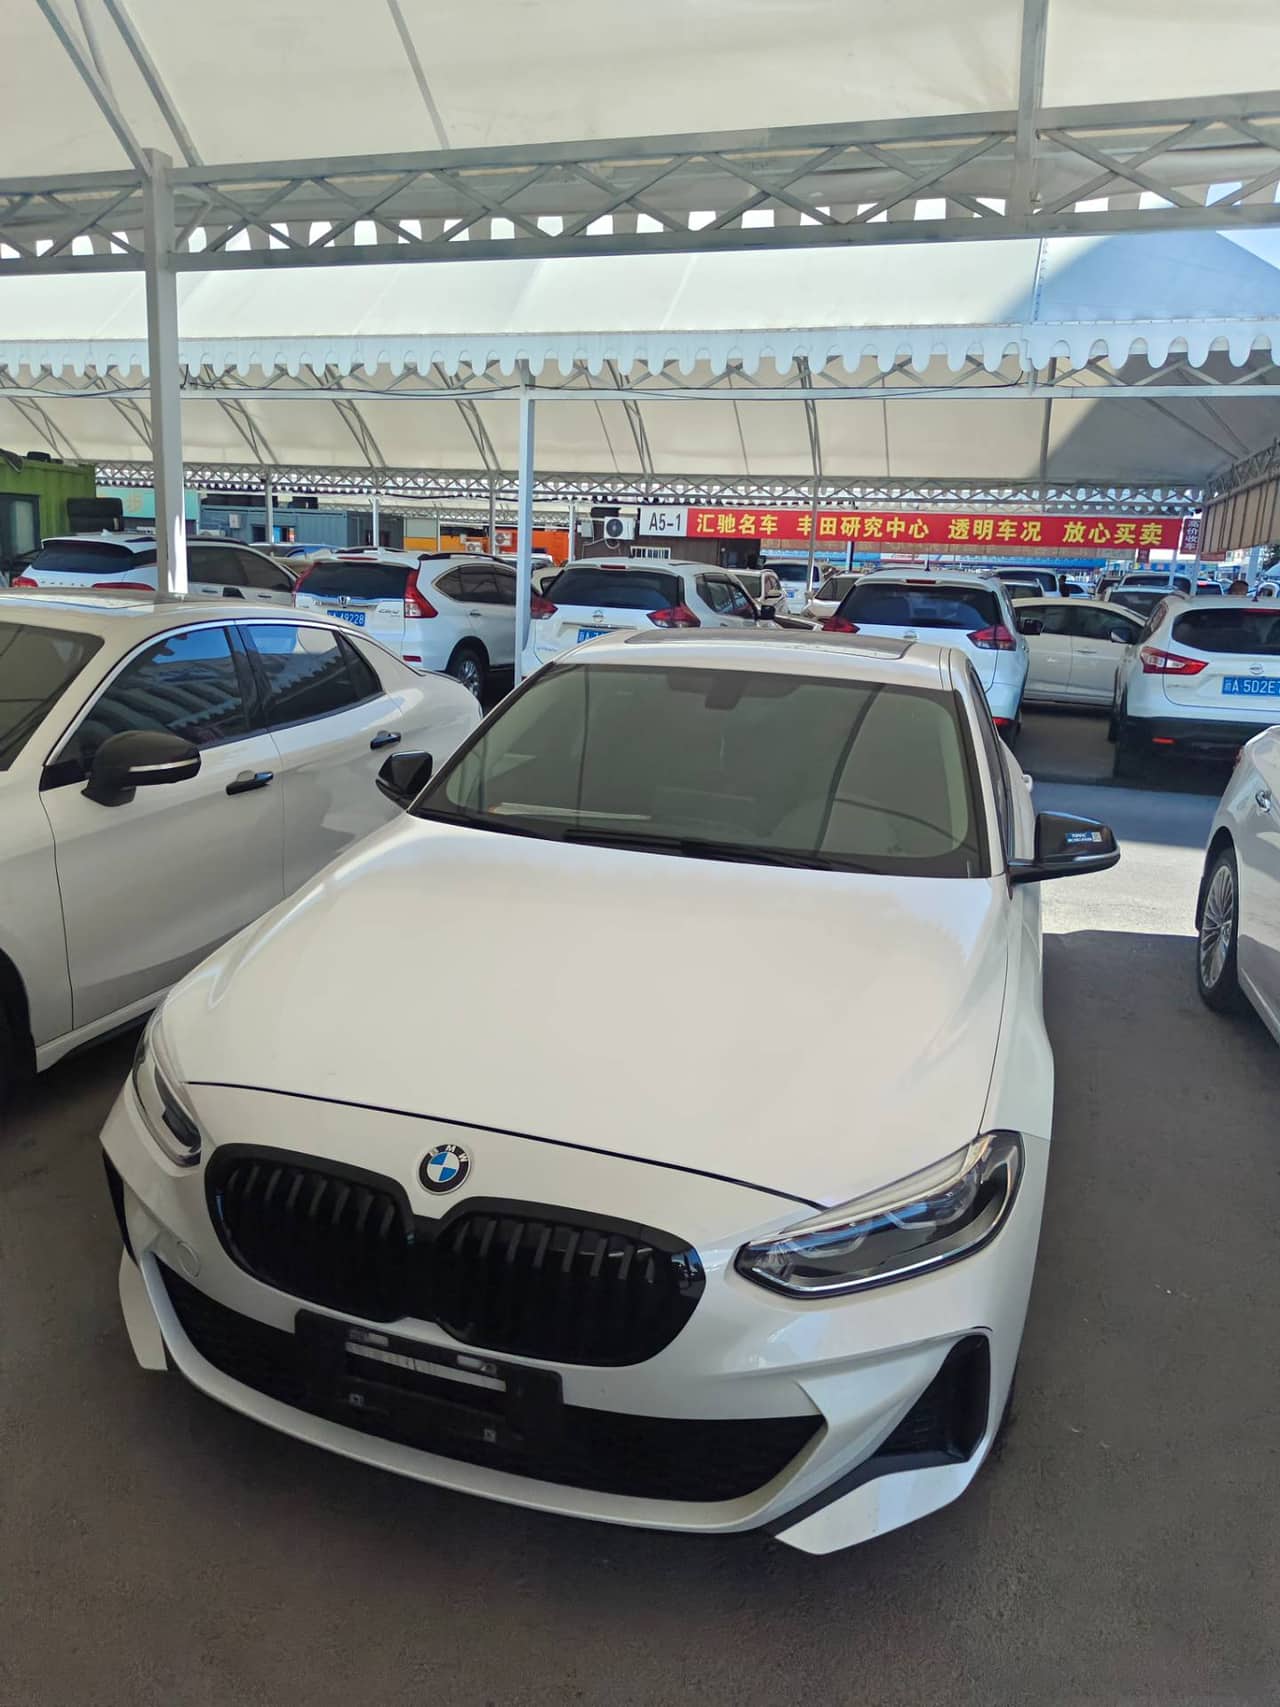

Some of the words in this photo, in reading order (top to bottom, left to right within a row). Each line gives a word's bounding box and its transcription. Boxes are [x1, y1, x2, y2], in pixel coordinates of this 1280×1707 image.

[649, 511, 681, 532] A5-1
[697, 513, 779, 535] 汇驰名车
[796, 515, 929, 539] 丰田研究中心
[948, 518, 1043, 542] 透明车况
[1062, 521, 1163, 545] 放心买卖
